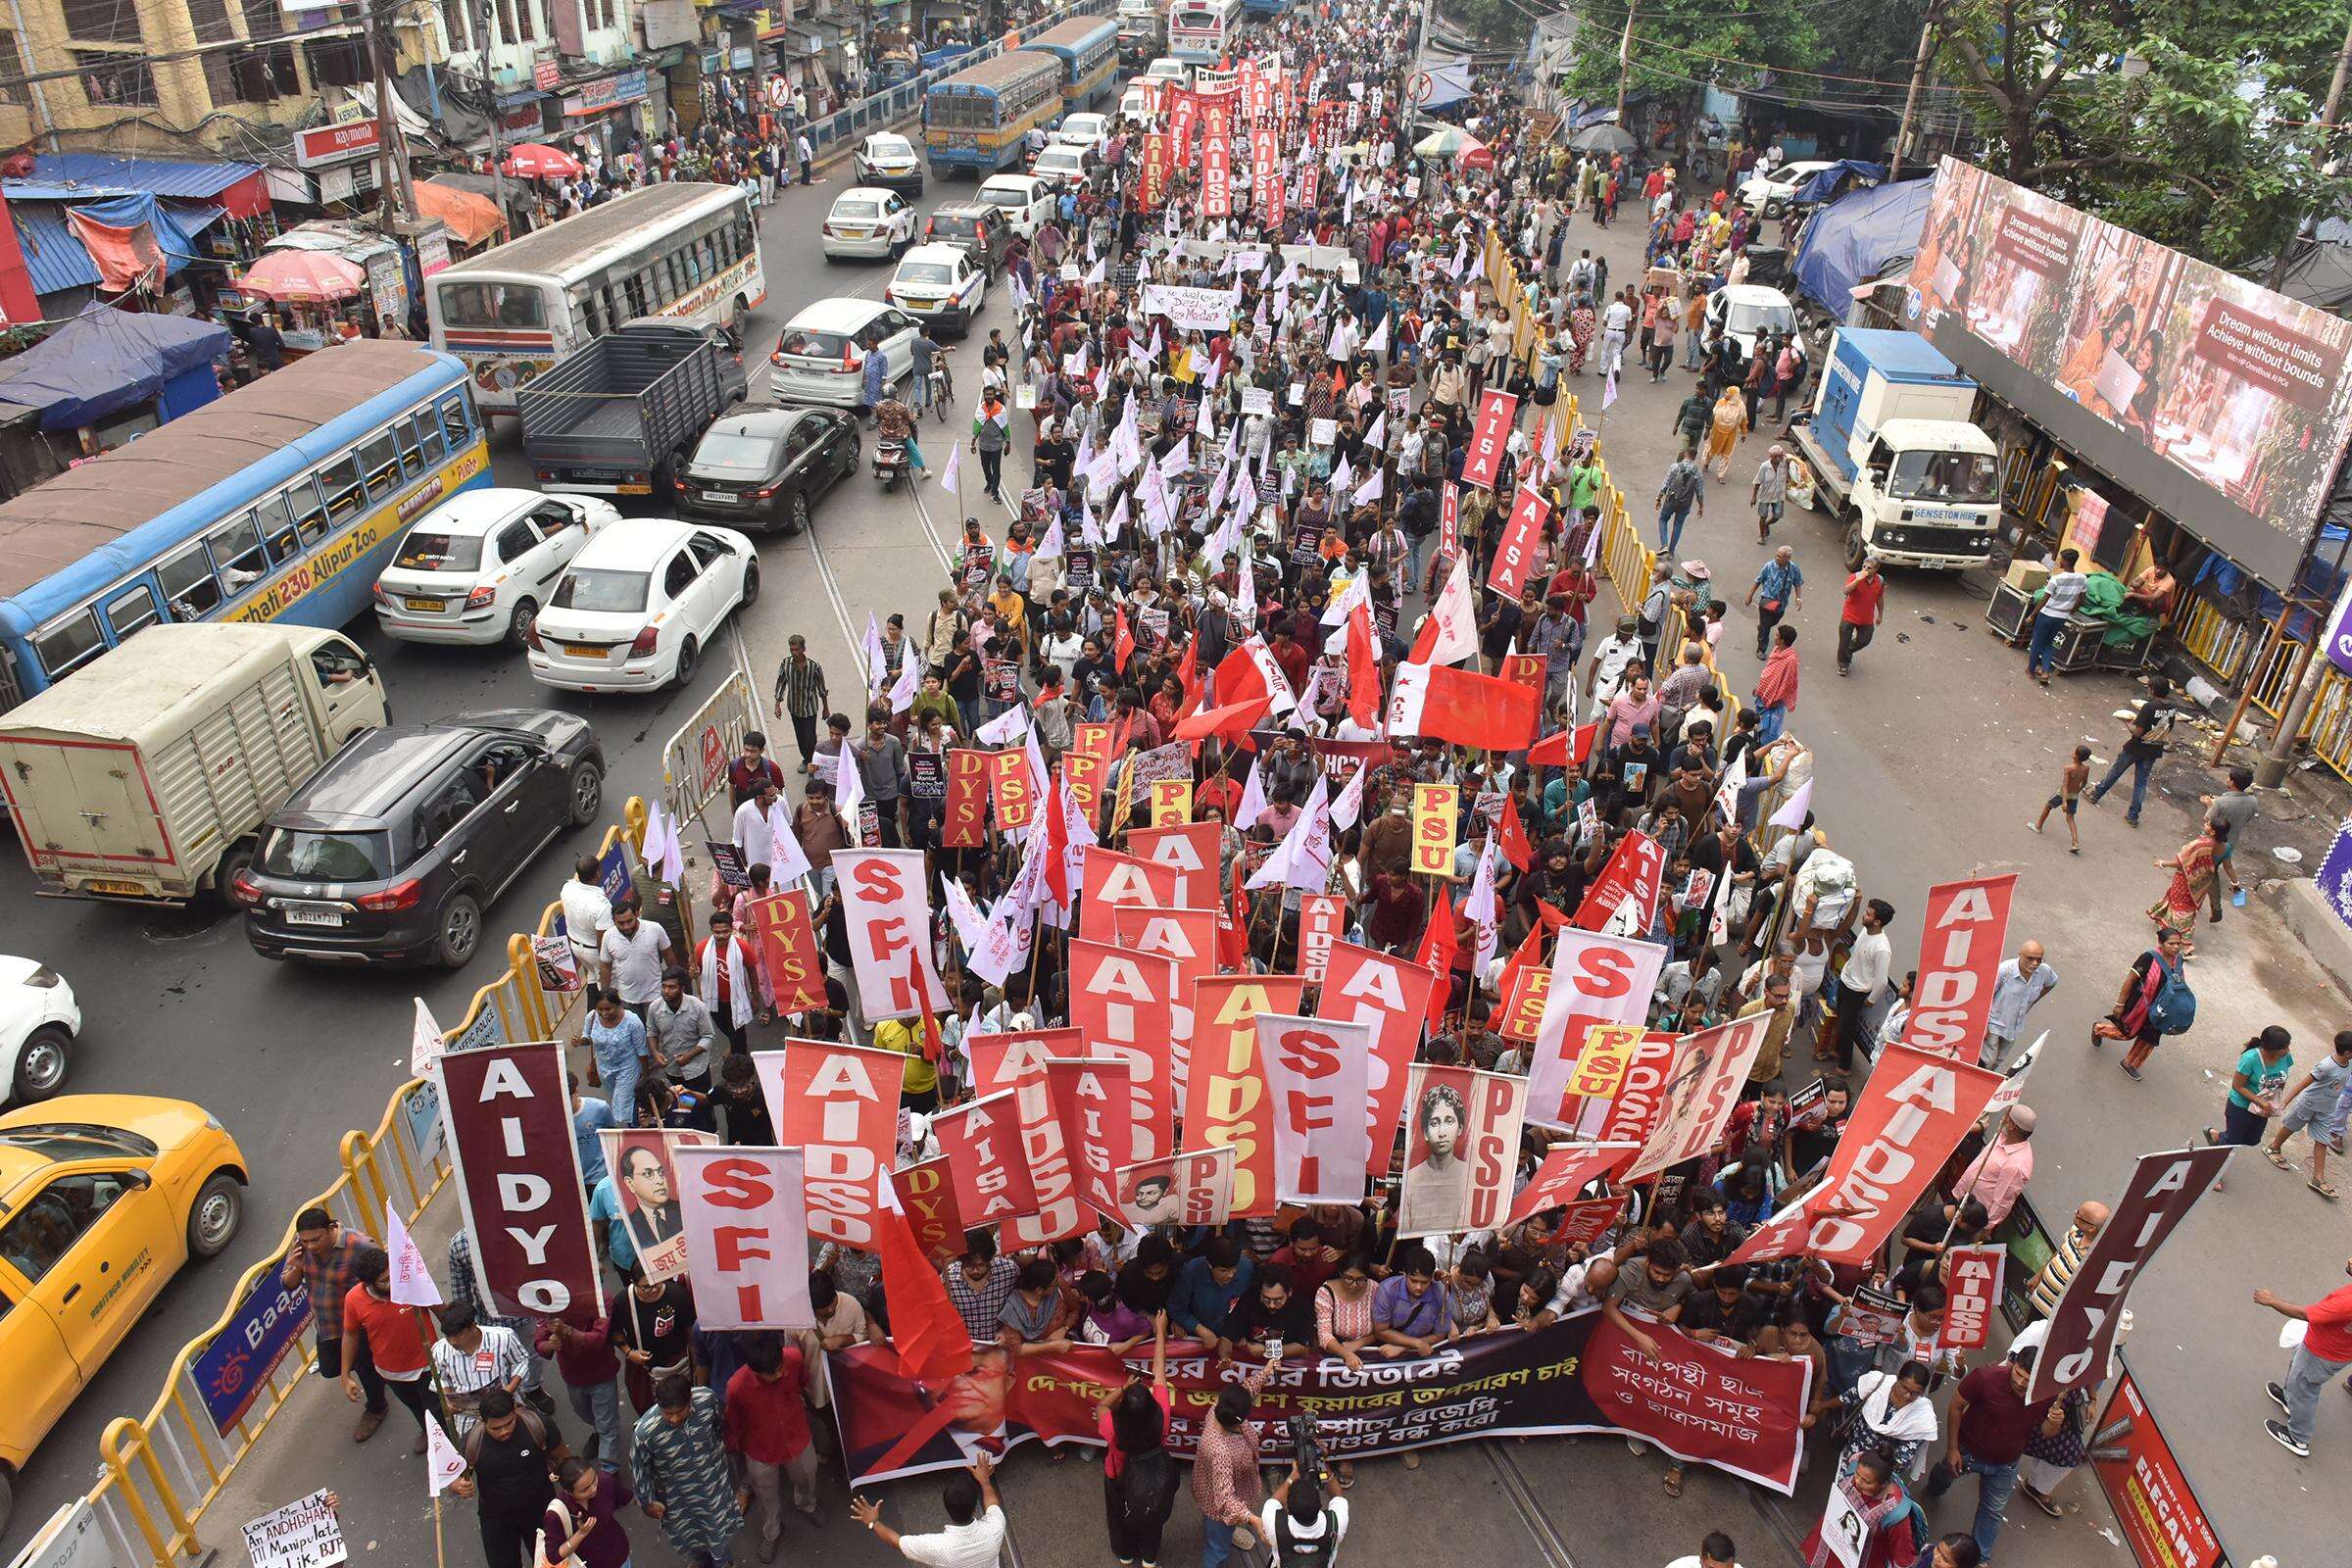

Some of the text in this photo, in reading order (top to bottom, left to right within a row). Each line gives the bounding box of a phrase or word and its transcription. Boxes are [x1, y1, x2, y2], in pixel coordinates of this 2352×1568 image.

[1206, 138, 1226, 214] AIDSO
[1301, 168, 1317, 204] AISA
[2009, 215, 2030, 232] Dream
[2206, 323, 2326, 389] Achieve without bounds
[2219, 311, 2324, 368] Dream without limits
[1473, 397, 1504, 475] AISA
[1444, 484, 1455, 553] AISA
[1499, 501, 1538, 588] AISA
[279, 567, 311, 605] 230
[313, 542, 352, 583] Alipur
[351, 526, 377, 564] Zoo
[953, 754, 983, 845] DYSA
[998, 754, 1026, 824] PSU
[1159, 784, 1185, 826] PS
[1421, 789, 1451, 870] PSU
[854, 858, 912, 1010] SFI
[1594, 897, 1617, 911] AIDS
[767, 899, 819, 1010] DYSA
[1911, 886, 1994, 1047] AIDS
[1578, 1030, 1635, 1095] PSU
[1680, 1021, 1757, 1160] PSU
[804, 1054, 881, 1244] AIDSO
[1077, 1072, 1118, 1207] AISA
[1279, 1029, 1342, 1195] SFI
[479, 1057, 571, 1313] AIDYO
[963, 1106, 1017, 1215] AISA
[1185, 1155, 1218, 1224] PSU
[1470, 1078, 1513, 1228] PSU
[1807, 1064, 1956, 1253] AIDSO
[702, 1157, 774, 1322] SFI
[2054, 1160, 2193, 1384] AIDYO
[1946, 1260, 1990, 1344] AIDSO
[243, 1518, 274, 1536] Love
[248, 1506, 333, 1549] An ANDHBHAKT
[2134, 1454, 2200, 1568] ELEGANT
[2154, 1460, 2194, 1536] PRIMARY STEEL
[270, 1521, 340, 1558] Manipulate
[318, 1537, 344, 1558] BJP
